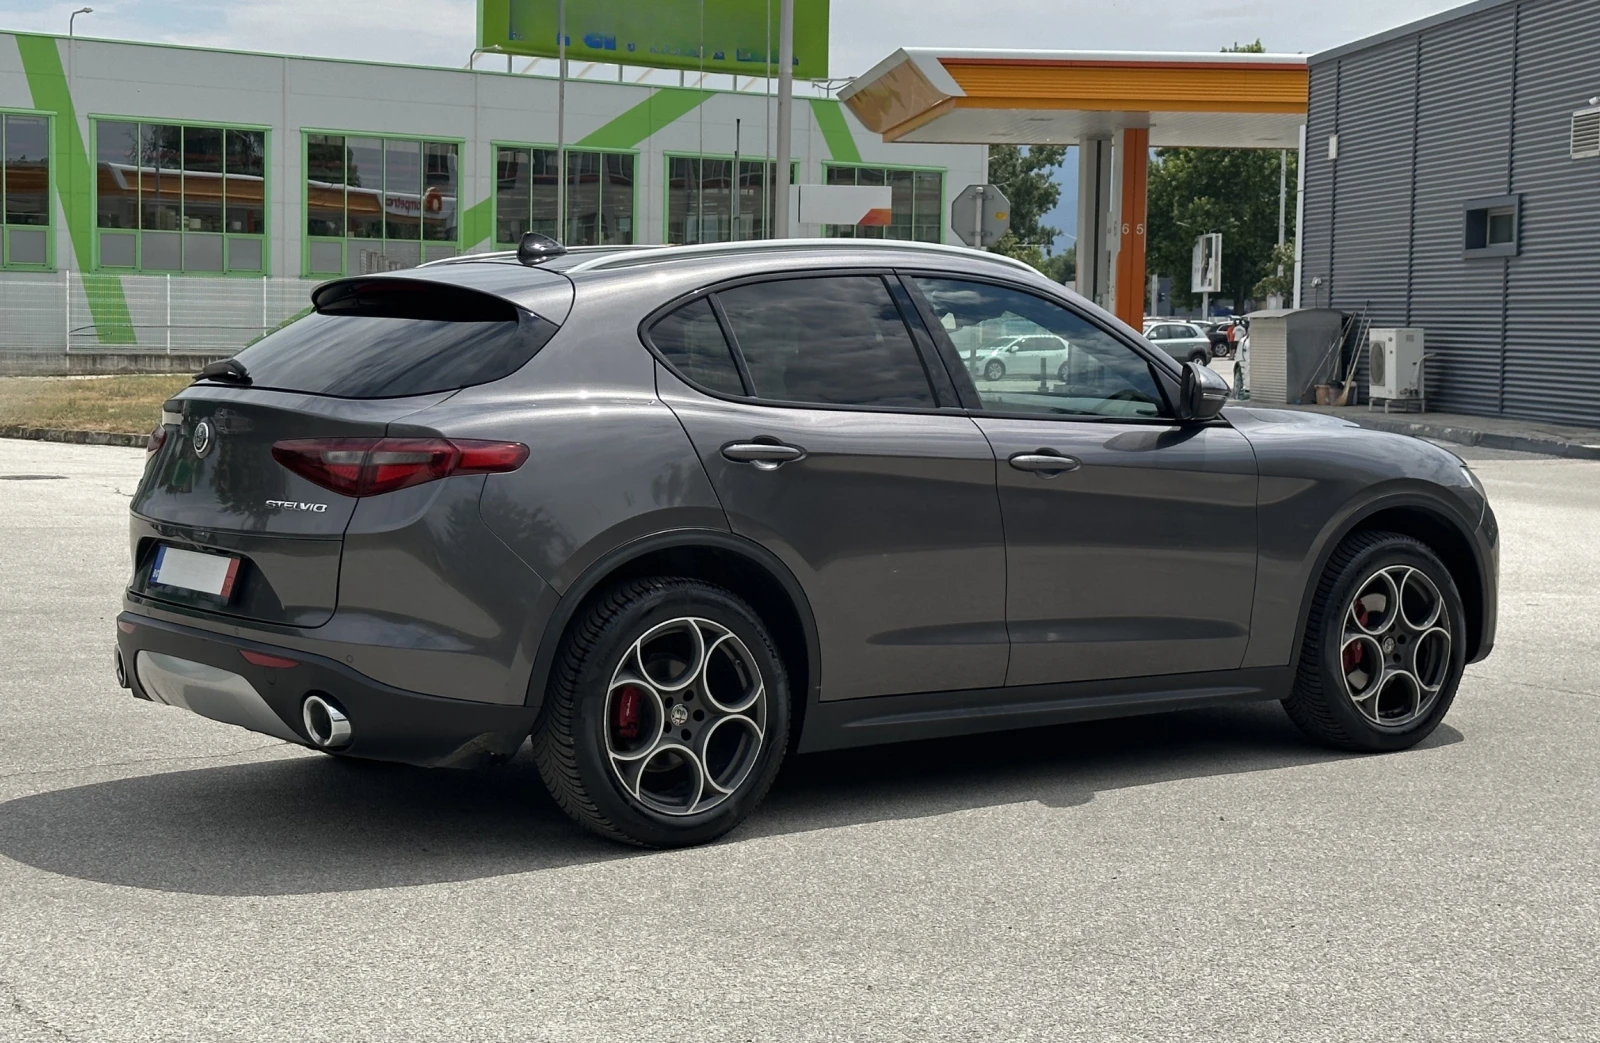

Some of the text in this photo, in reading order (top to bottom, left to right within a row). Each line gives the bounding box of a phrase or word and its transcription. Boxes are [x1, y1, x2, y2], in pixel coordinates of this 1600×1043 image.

[1122, 223, 1130, 234] 6
[1136, 223, 1144, 234] 5
[265, 500, 328, 512] STELVIO
